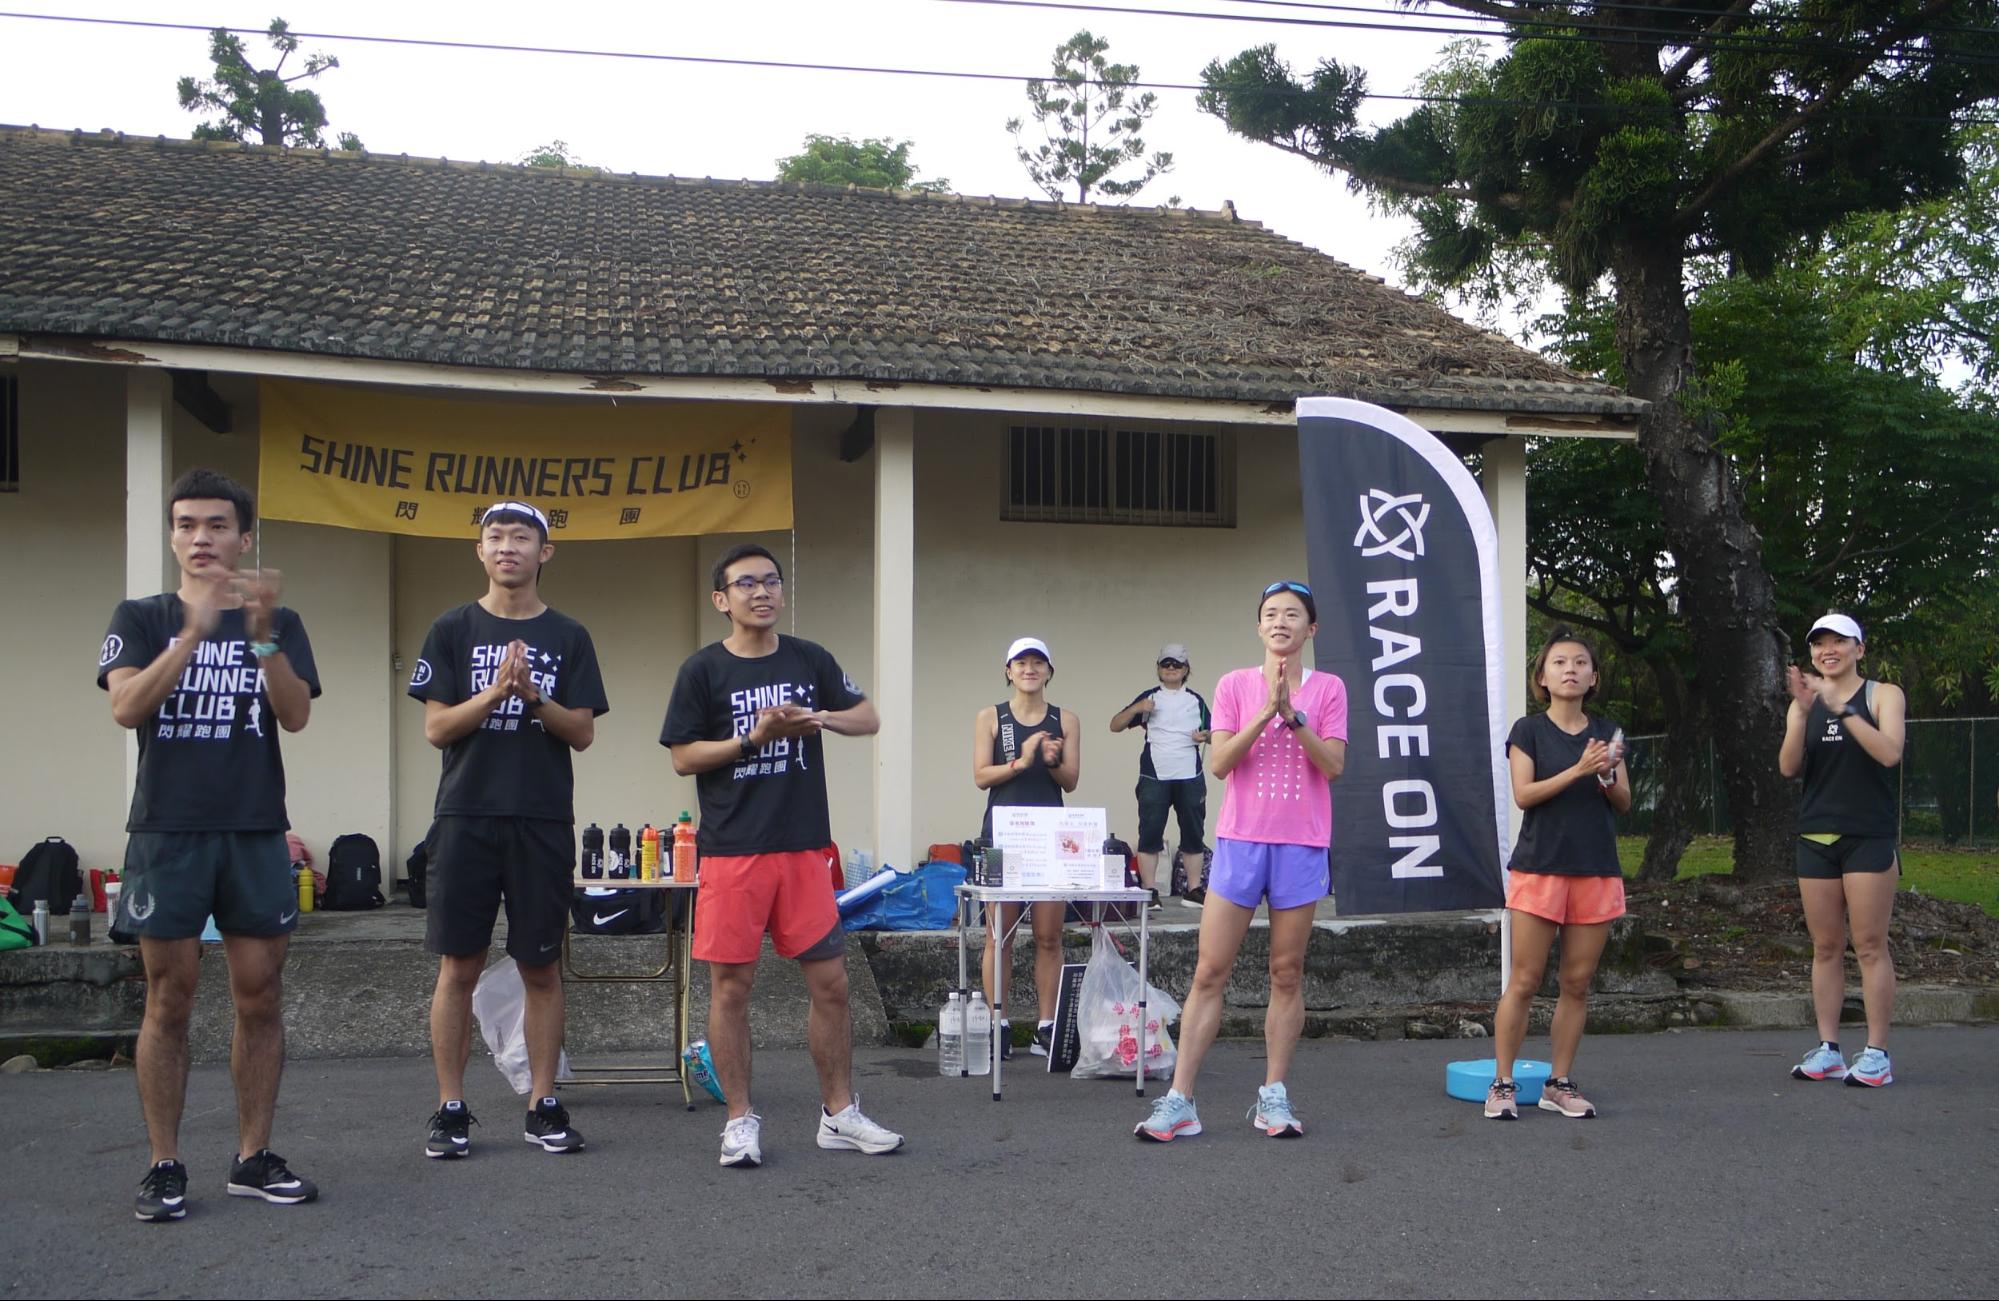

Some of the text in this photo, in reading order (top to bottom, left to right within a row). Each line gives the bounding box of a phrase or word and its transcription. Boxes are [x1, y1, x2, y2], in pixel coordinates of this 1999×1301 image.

[301, 434, 730, 496] SHINE RUNNERS CLUB
[471, 644, 537, 668] SHIE
[731, 682, 792, 715] SHINE
[158, 723, 231, 739] 閃耀跑團
[1002, 724, 1015, 752] NIKE
[1366, 578, 1445, 880] RACE ON
